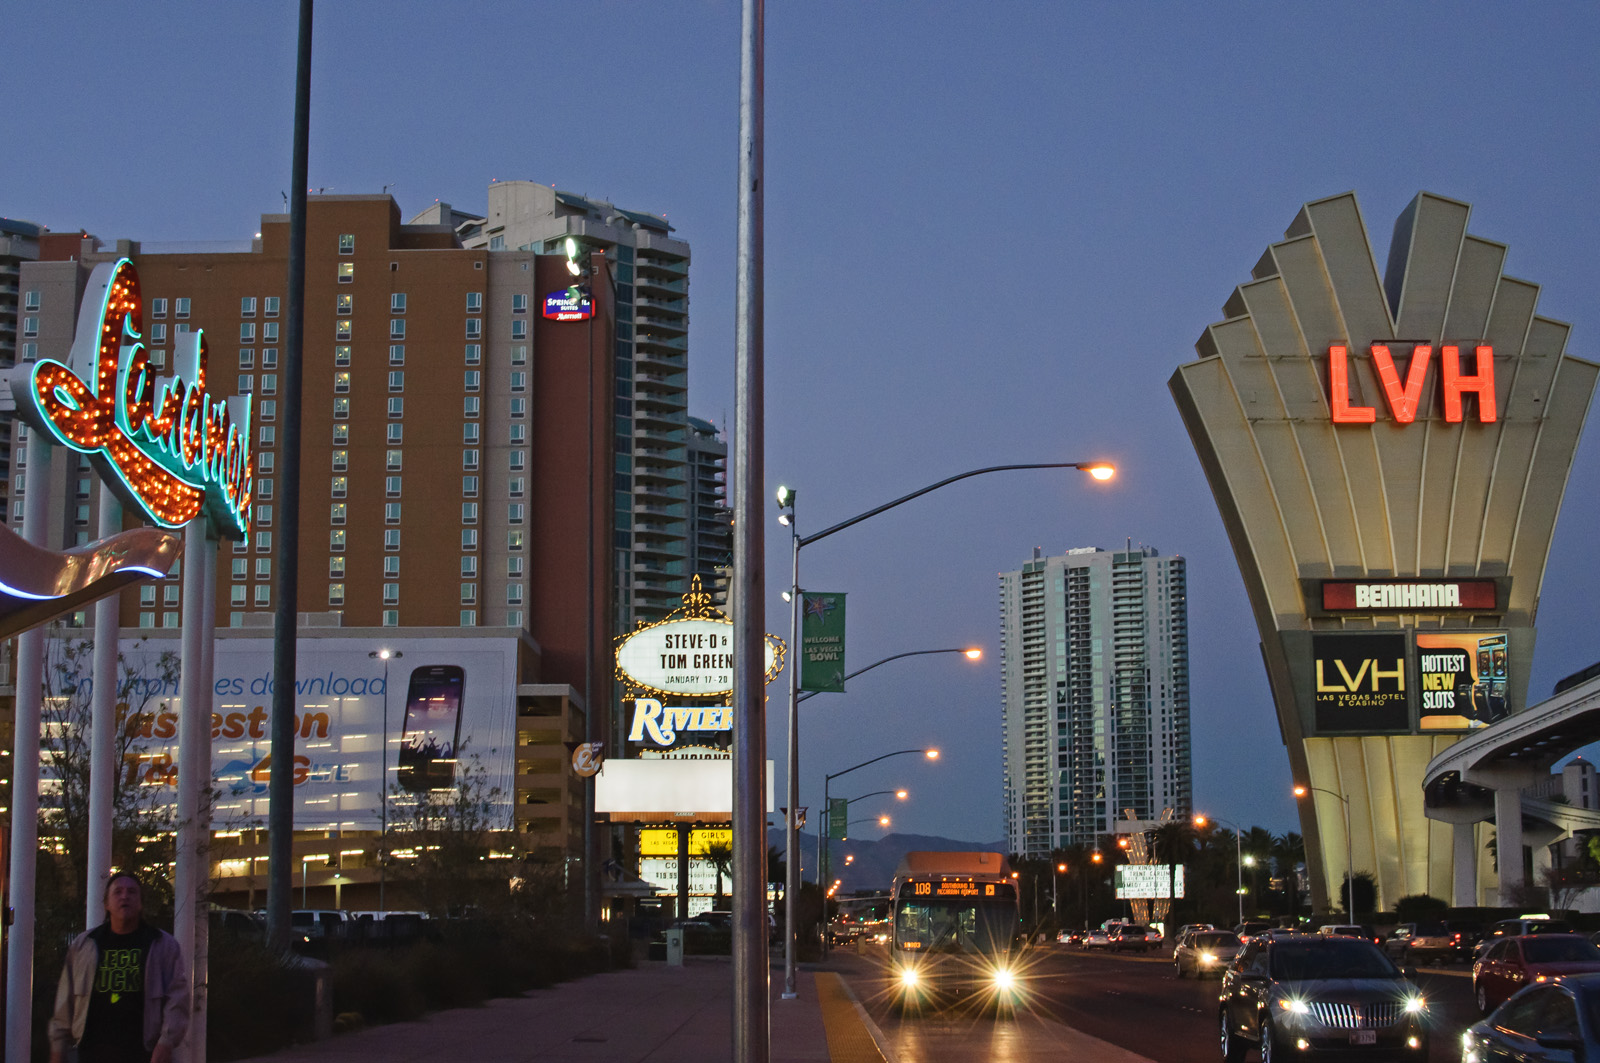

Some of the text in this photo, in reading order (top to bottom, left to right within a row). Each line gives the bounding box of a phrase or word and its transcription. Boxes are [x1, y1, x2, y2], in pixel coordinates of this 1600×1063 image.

[1329, 345, 1497, 423] LVH
[665, 633, 728, 649] STEVE-O &
[804, 636, 840, 644] WELCOME
[660, 654, 733, 669] TOM GREEN
[810, 652, 839, 661] BOWL
[1421, 654, 1465, 673] HOTTEST
[665, 675, 699, 684] JANUARY
[1316, 658, 1405, 693] LVH
[1422, 673, 1455, 690] NEW
[1423, 691, 1455, 709] SLOTS
[114, 702, 268, 739] fasest
[582, 752, 592, 768] 2
[915, 882, 931, 895] 108
